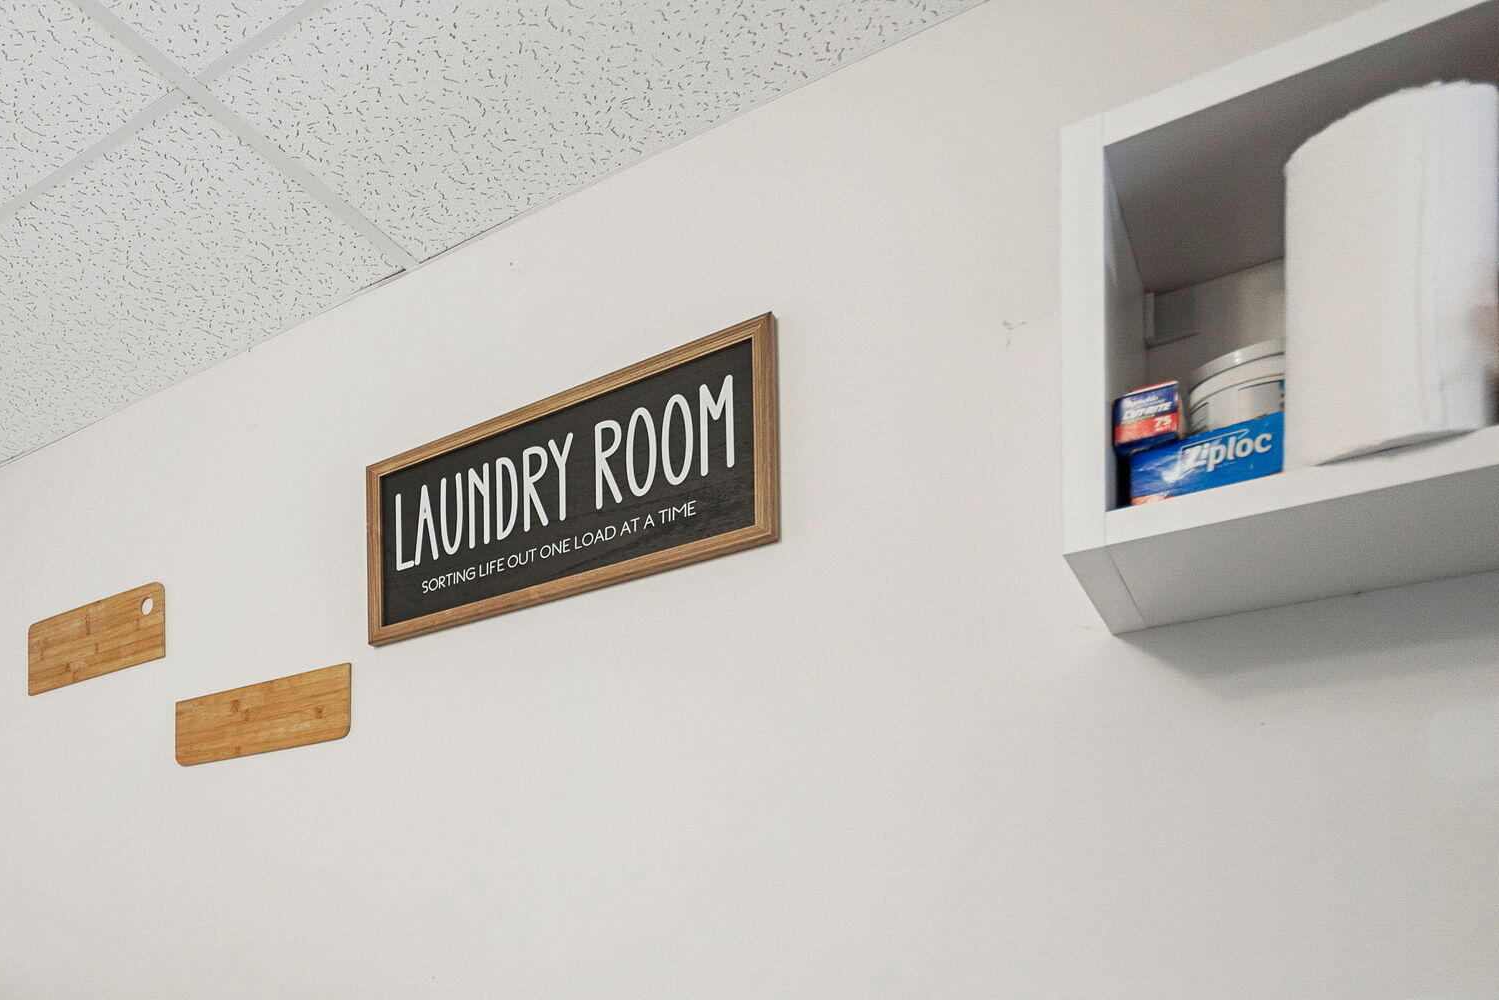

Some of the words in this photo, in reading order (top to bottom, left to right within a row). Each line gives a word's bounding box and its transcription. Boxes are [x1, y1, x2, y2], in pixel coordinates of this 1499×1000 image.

[1153, 415, 1172, 428] 75
[1183, 433, 1272, 472] Ziploc
[395, 433, 574, 573] LAUNDRY
[594, 374, 735, 511] ROOM
[421, 567, 476, 594] SORTING
[479, 558, 505, 578] LIFE
[507, 547, 538, 569] OUT
[539, 537, 571, 560] ONE
[574, 525, 617, 550] LOAD
[620, 516, 641, 537] AT
[643, 513, 655, 530] A
[657, 500, 697, 524] TIME
